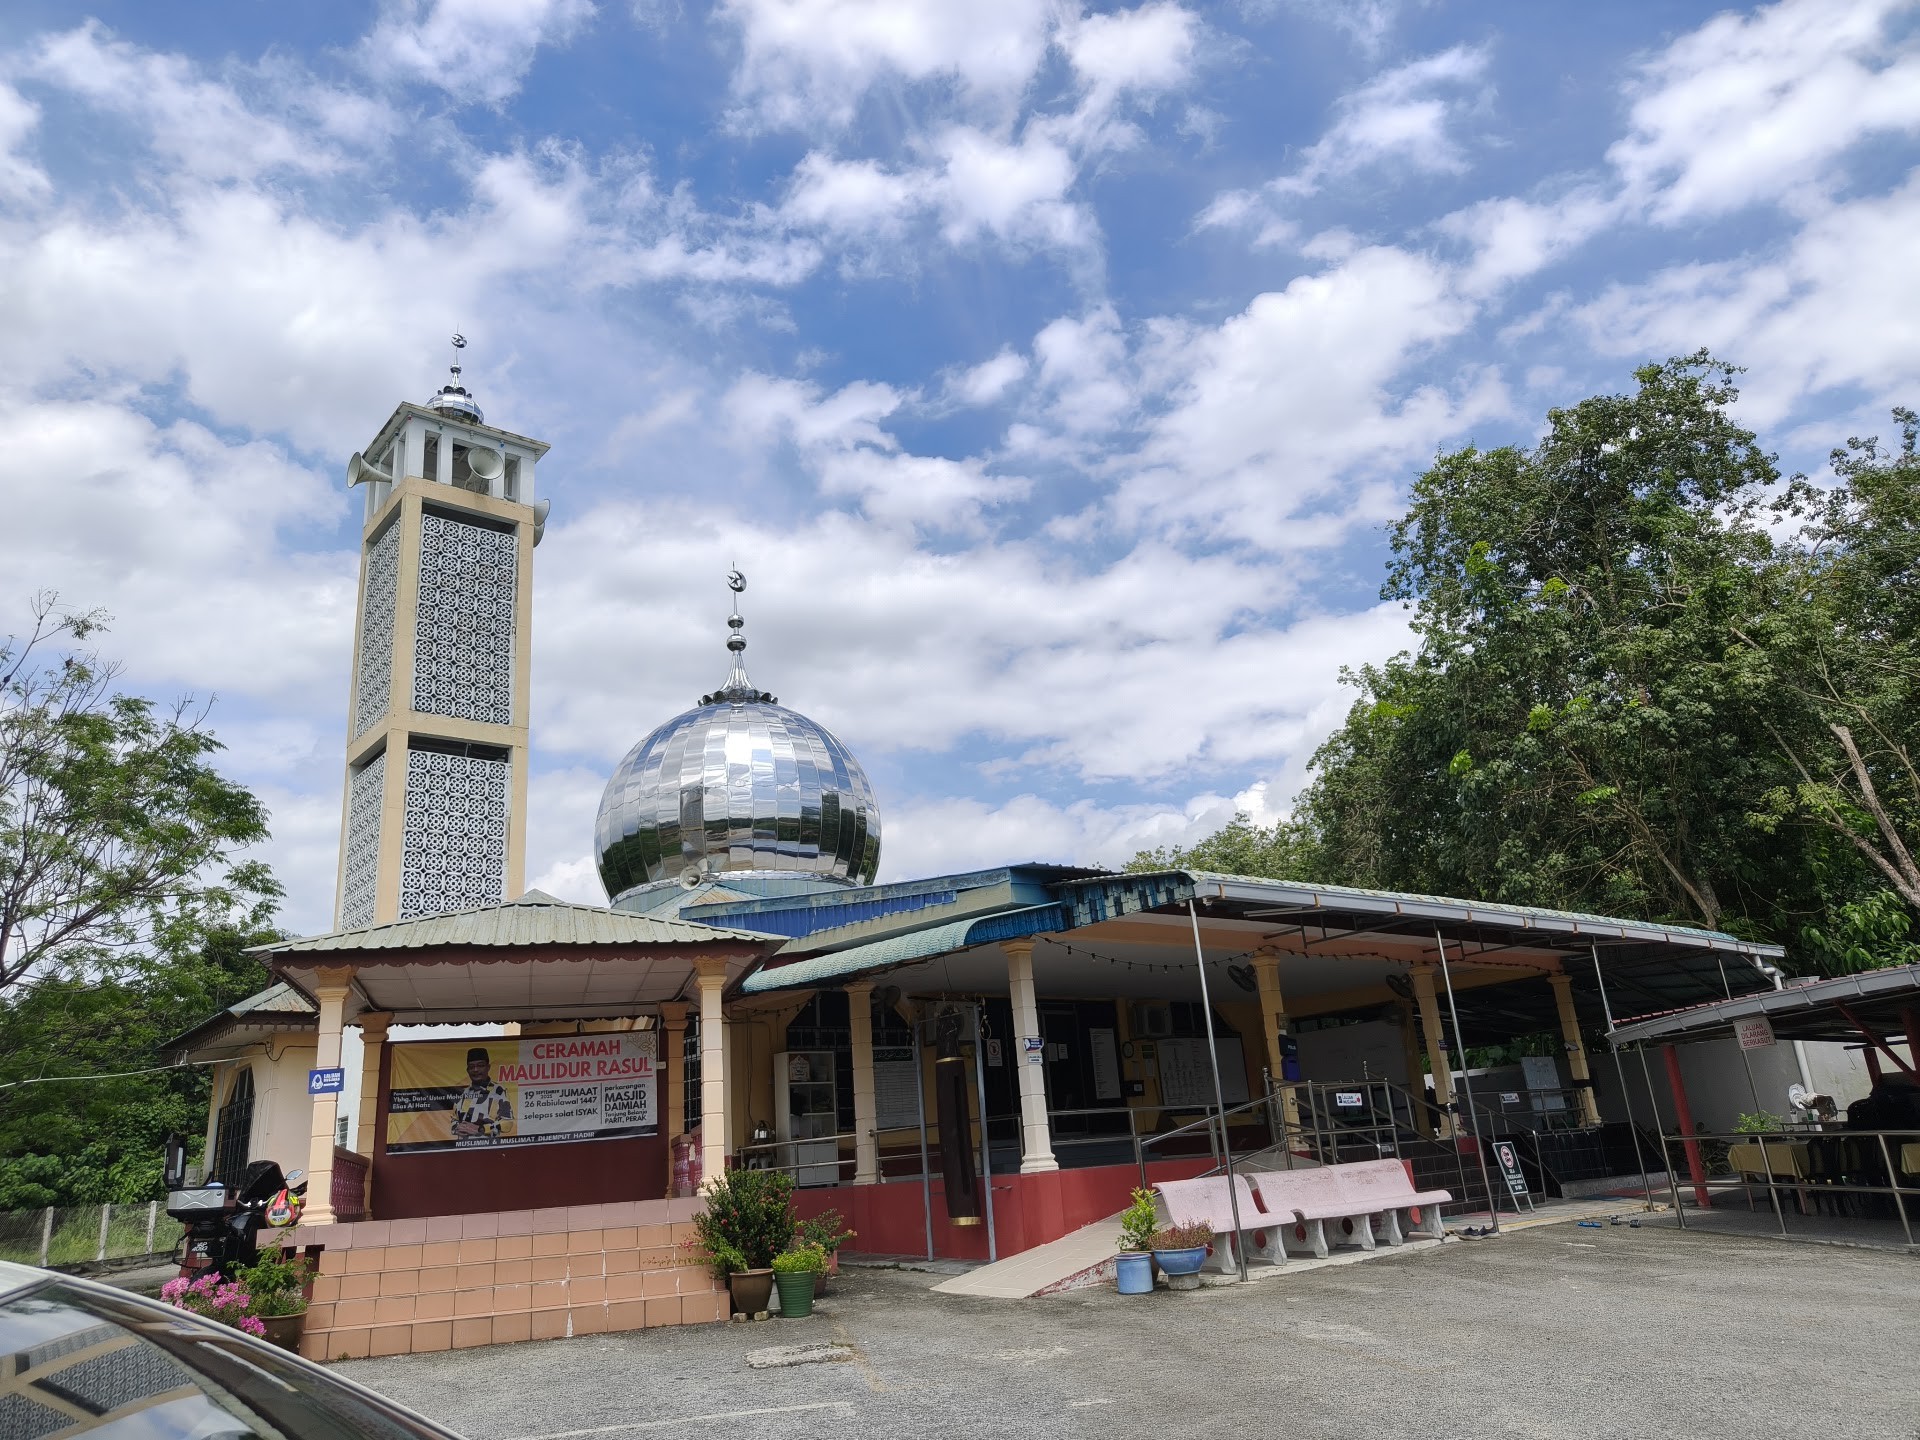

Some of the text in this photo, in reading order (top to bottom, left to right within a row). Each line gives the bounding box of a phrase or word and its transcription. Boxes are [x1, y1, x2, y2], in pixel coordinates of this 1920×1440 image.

[1742, 1023, 1764, 1032] LALUAN
[1741, 1029, 1769, 1040] DILARANG
[532, 1039, 621, 1060] CERAMAH
[498, 1056, 653, 1082] MAULIDUR RASUL
[559, 1087, 598, 1098] JUMAAT
[604, 1082, 646, 1093] perkarangan
[524, 1091, 535, 1100] 19
[604, 1090, 647, 1103] MASJID
[536, 1097, 579, 1108] Rabiulawal
[580, 1096, 597, 1104] 1447
[604, 1100, 647, 1112] DAIMIAH
[524, 1107, 598, 1120] selepas solat ISYAK
[625, 1114, 647, 1123] PERAK
[455, 1139, 490, 1148] MUSLIMIN
[500, 1136, 536, 1145] MUSLIMAT
[537, 1133, 571, 1142] DIJEMPUT
[573, 1131, 595, 1139] HADIR
